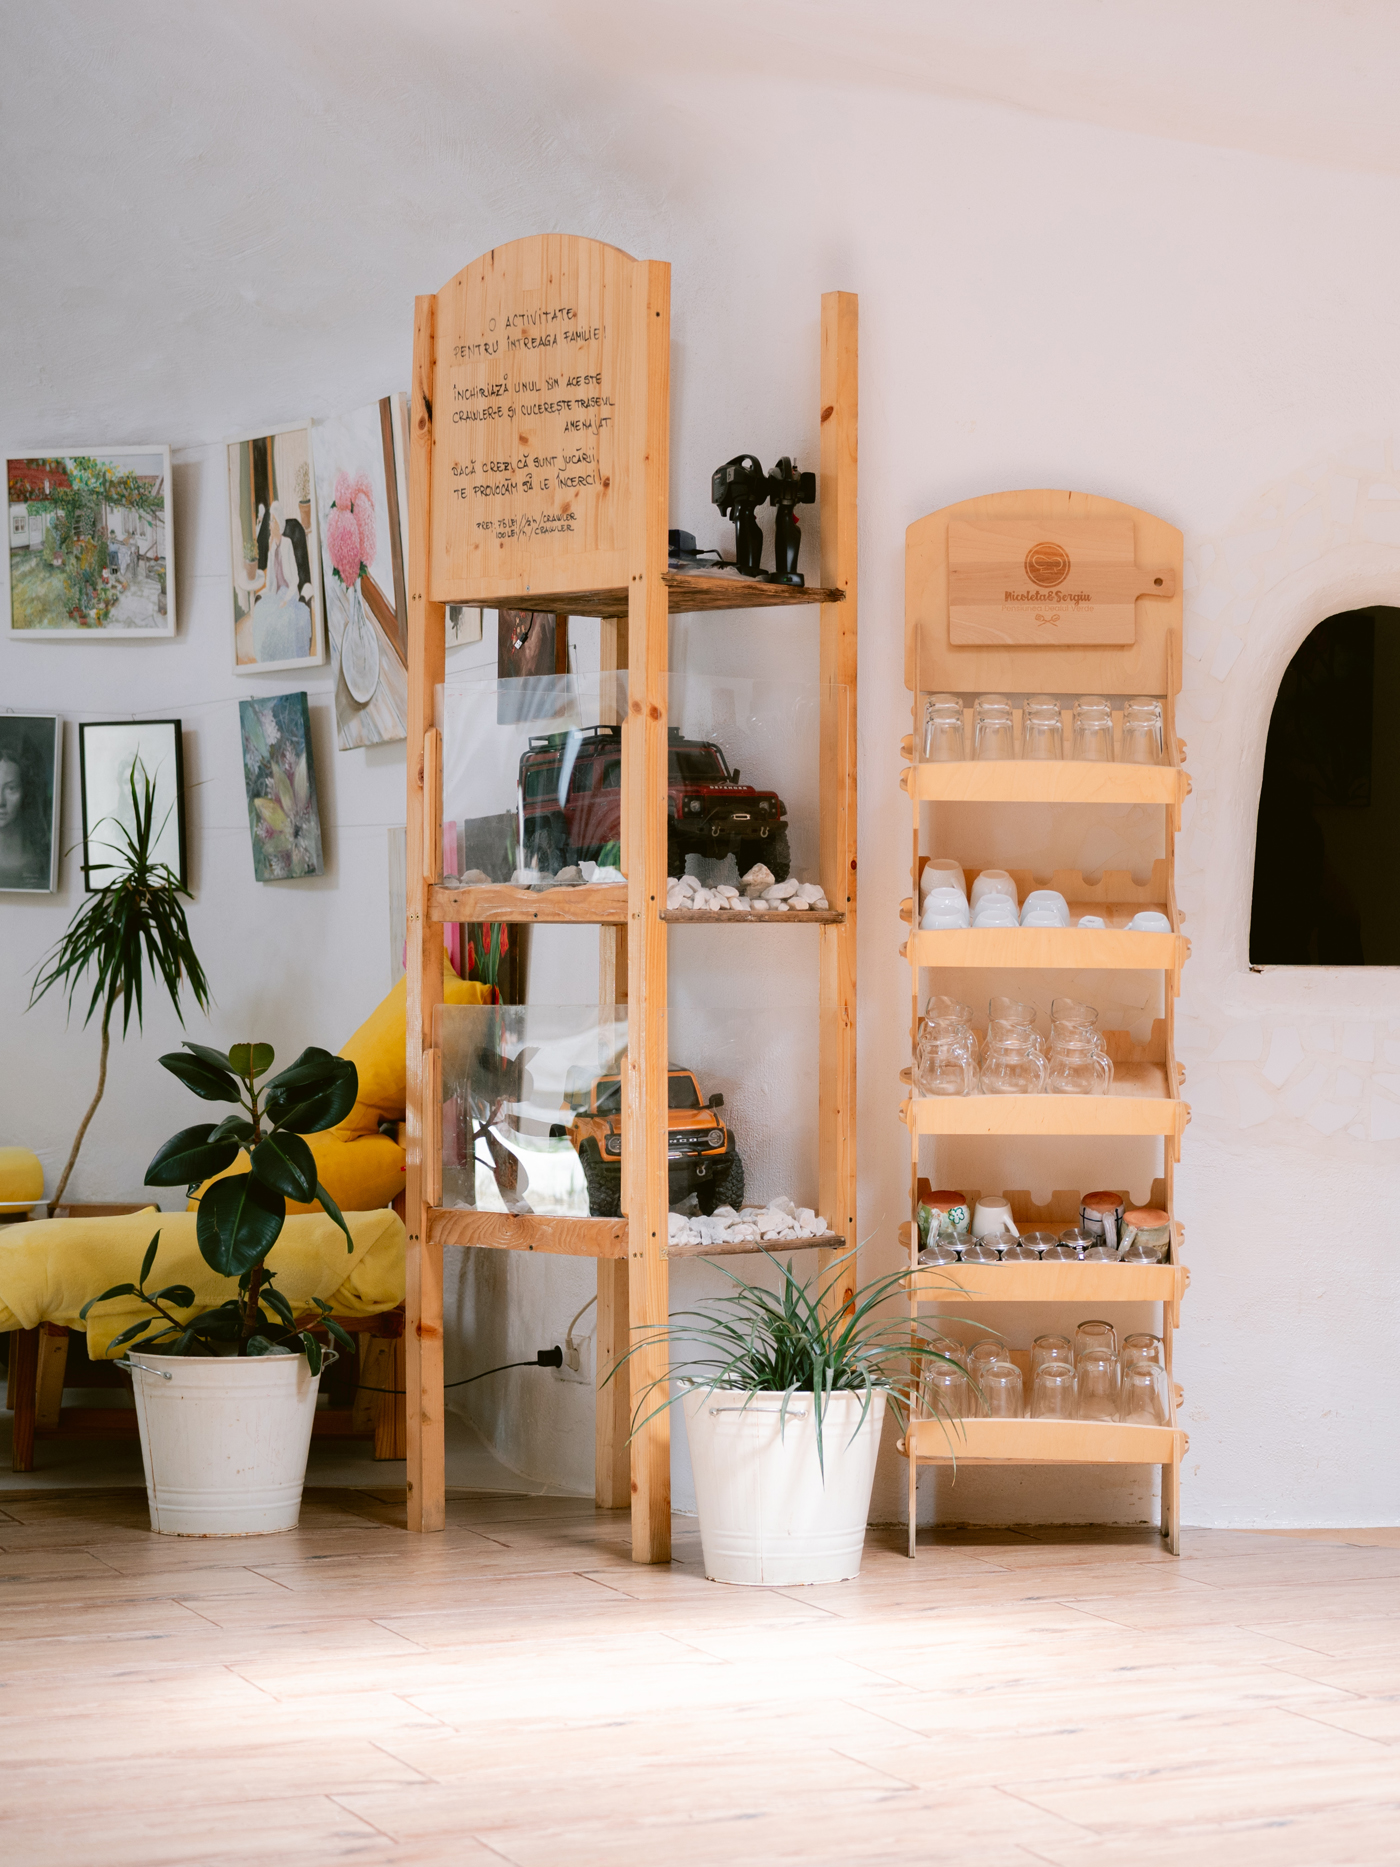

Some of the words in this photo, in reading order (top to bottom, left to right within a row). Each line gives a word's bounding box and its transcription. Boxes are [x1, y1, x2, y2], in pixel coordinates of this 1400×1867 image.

[489, 318, 497, 332] O
[505, 308, 573, 330] ACTIVITATE
[453, 340, 499, 359] PENTRU
[514, 380, 542, 393] UNUL
[546, 377, 560, 391] DIN
[566, 373, 602, 388] ACESTE
[452, 406, 504, 424] CRAWLER-E
[575, 396, 616, 409] TRASEUL
[533, 456, 558, 468] SUNT
[454, 488, 467, 500] TE
[540, 478, 550, 491] LE
